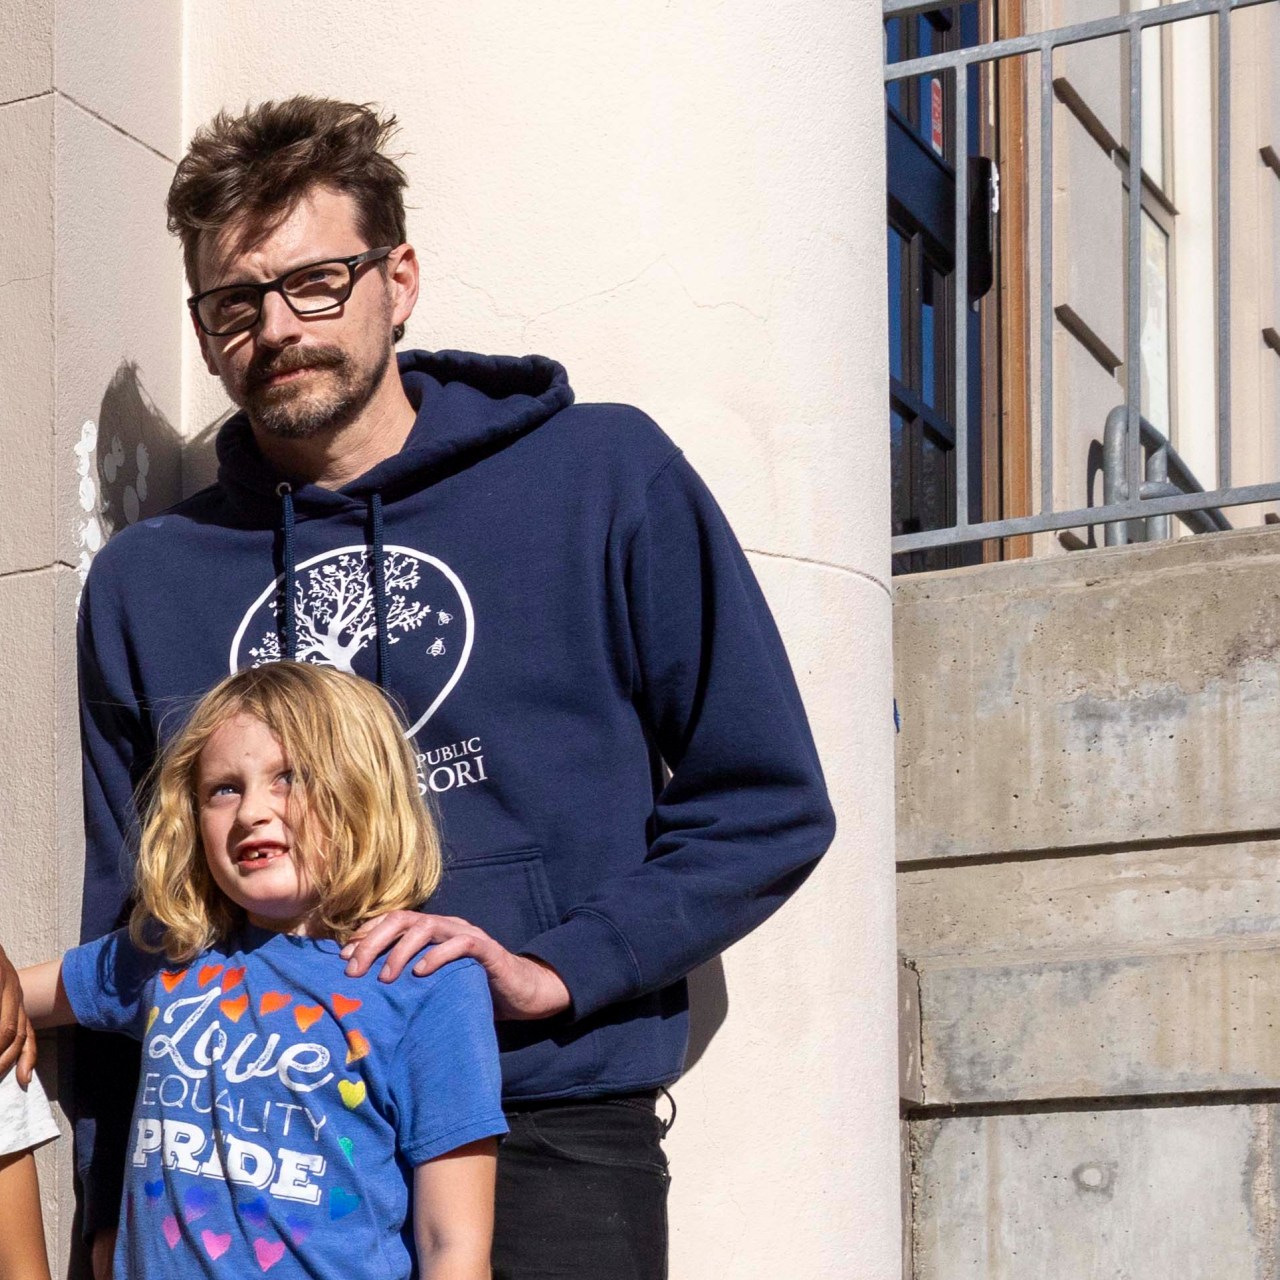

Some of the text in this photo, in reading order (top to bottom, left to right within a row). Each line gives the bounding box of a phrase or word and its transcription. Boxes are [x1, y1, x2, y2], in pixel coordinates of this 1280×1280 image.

[149, 986, 335, 1092] Love
[143, 1072, 327, 1141] EQUALITY
[133, 1118, 327, 1205] PRIDE
